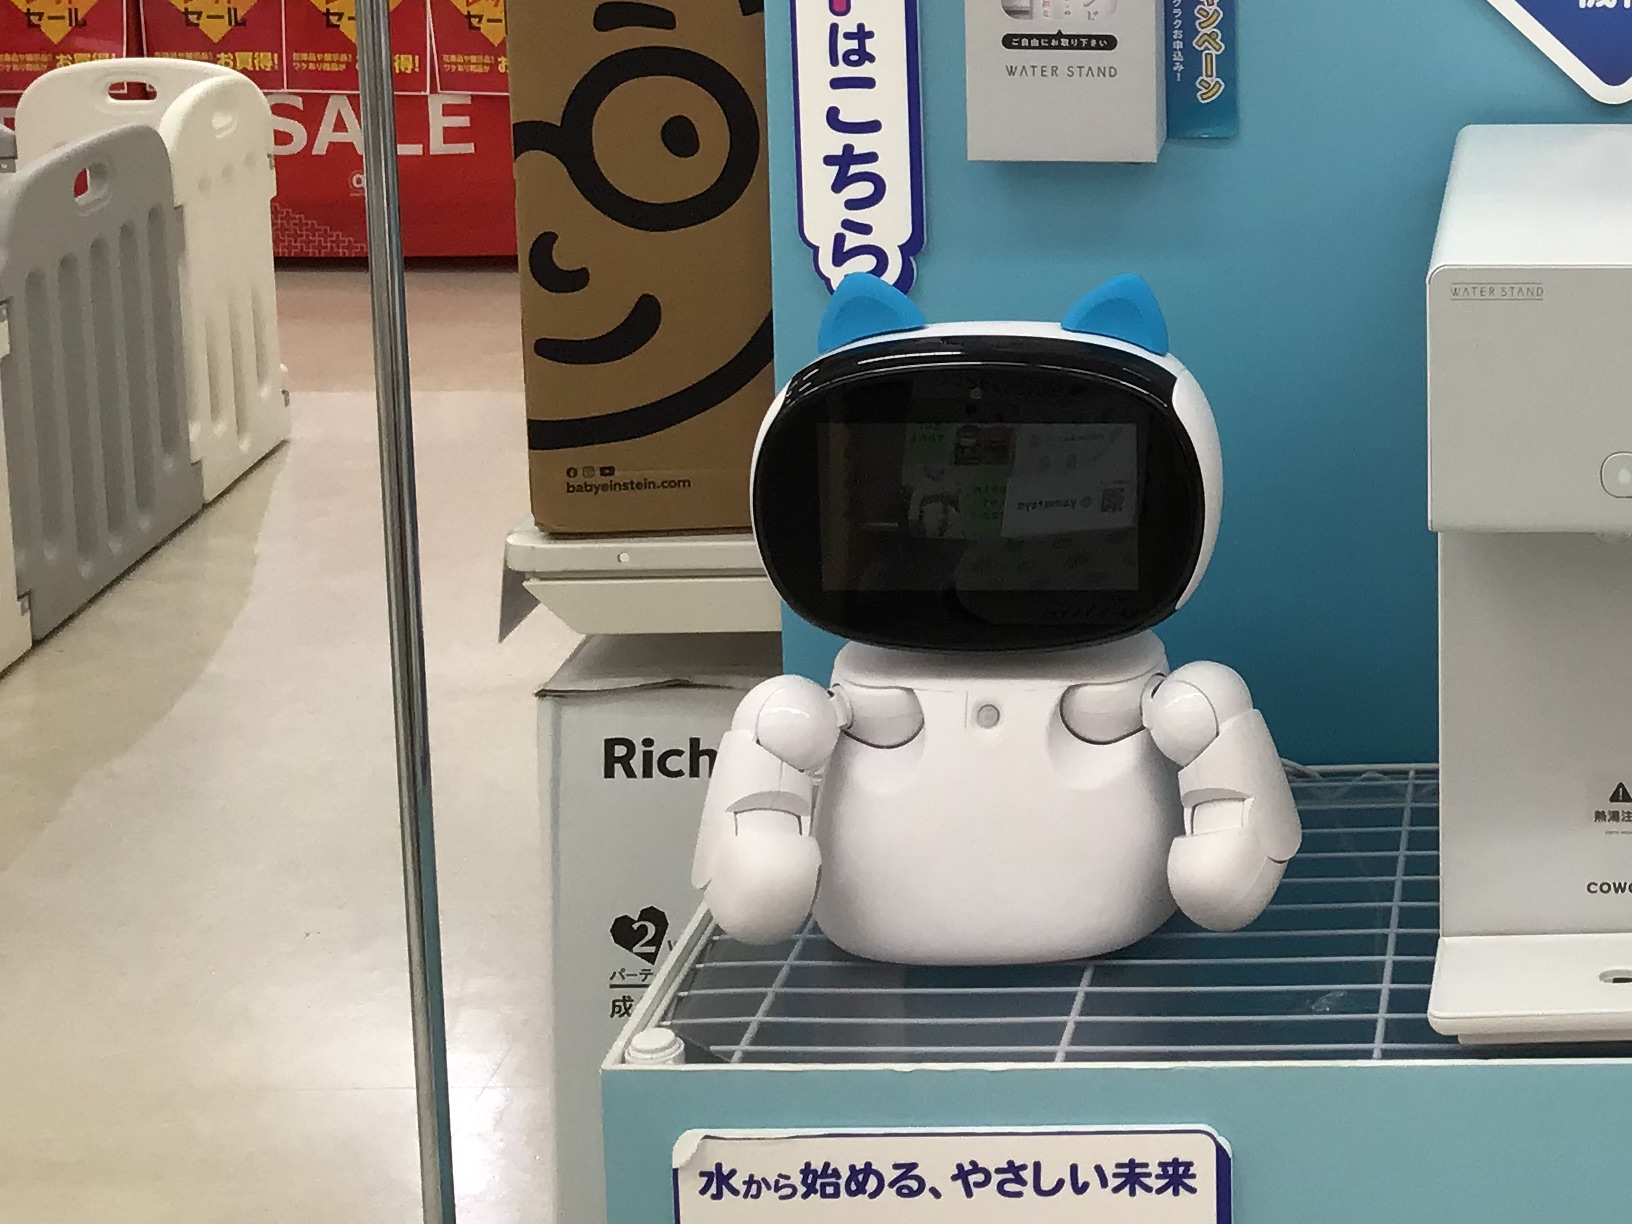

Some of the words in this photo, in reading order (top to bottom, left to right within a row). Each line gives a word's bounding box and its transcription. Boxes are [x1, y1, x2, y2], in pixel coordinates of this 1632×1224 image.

[24, 7, 87, 28] セール
[183, 7, 247, 28] セール
[1012, 38, 1108, 47] ご自由にお取り下さい
[1005, 64, 1059, 78] WATER
[1066, 65, 1118, 78] STAND
[1450, 286, 1496, 297] WATER
[1501, 286, 1544, 298] STAND
[566, 477, 691, 495] babyeinstein.com
[602, 736, 718, 780] Rich
[632, 921, 657, 954] 2
[697, 1157, 1198, 1201] 水から始める、やさしい未来
